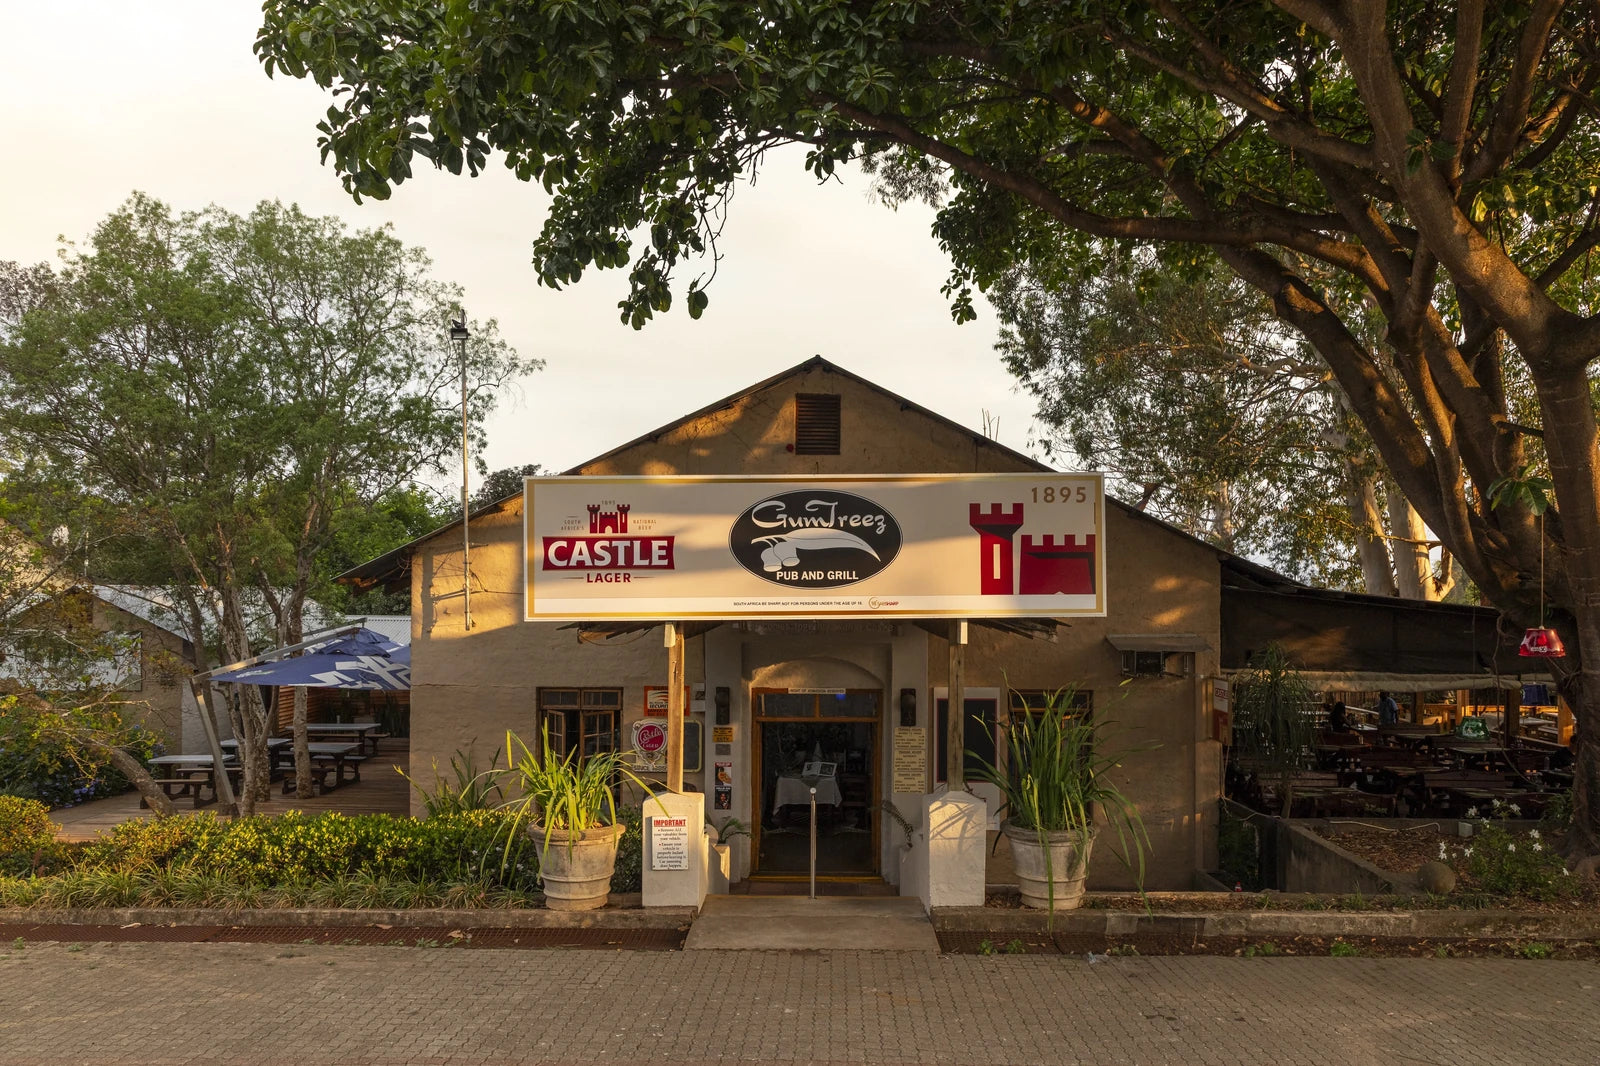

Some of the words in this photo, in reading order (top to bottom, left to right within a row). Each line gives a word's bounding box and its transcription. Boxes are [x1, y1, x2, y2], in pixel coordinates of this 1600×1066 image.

[1032, 486, 1086, 503] 1895
[752, 500, 886, 534] GumTreez
[548, 540, 668, 566] CASTLE
[586, 572, 632, 583] LAGER
[776, 571, 799, 580] PUB
[800, 571, 824, 580] AND
[826, 571, 859, 580] GRILL
